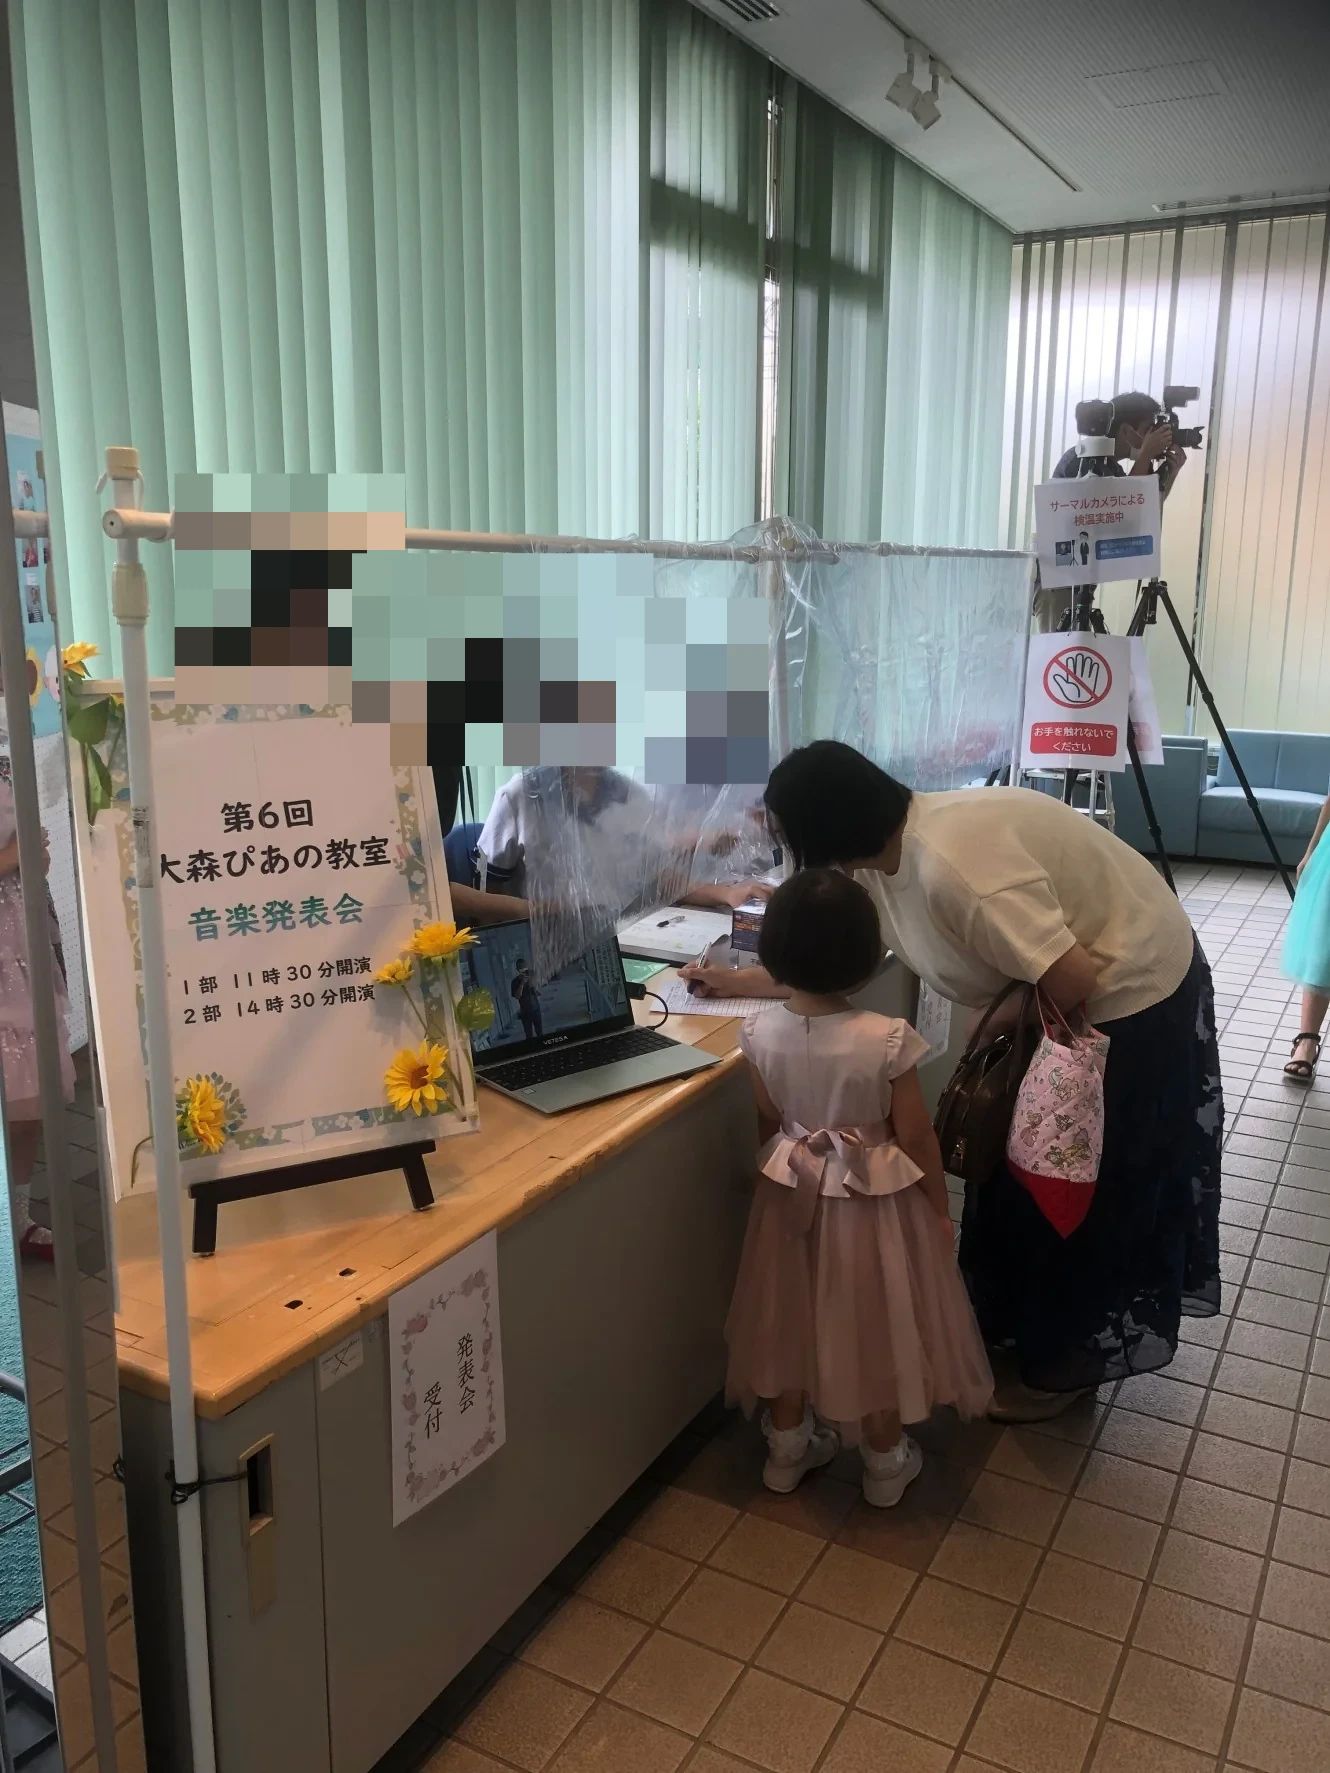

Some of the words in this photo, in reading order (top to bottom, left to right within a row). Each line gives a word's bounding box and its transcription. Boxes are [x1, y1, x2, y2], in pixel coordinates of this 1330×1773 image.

[1049, 493, 1145, 512] サーマルカメラによる
[1074, 511, 1124, 527] 検温実施中
[1033, 727, 1114, 739] お手を触れないで
[1052, 742, 1091, 752] ください
[220, 799, 314, 834] 第6回
[188, 893, 365, 942] 音楽発表会
[456, 1332, 476, 1415] 発表会
[423, 1381, 443, 1440] 受付
